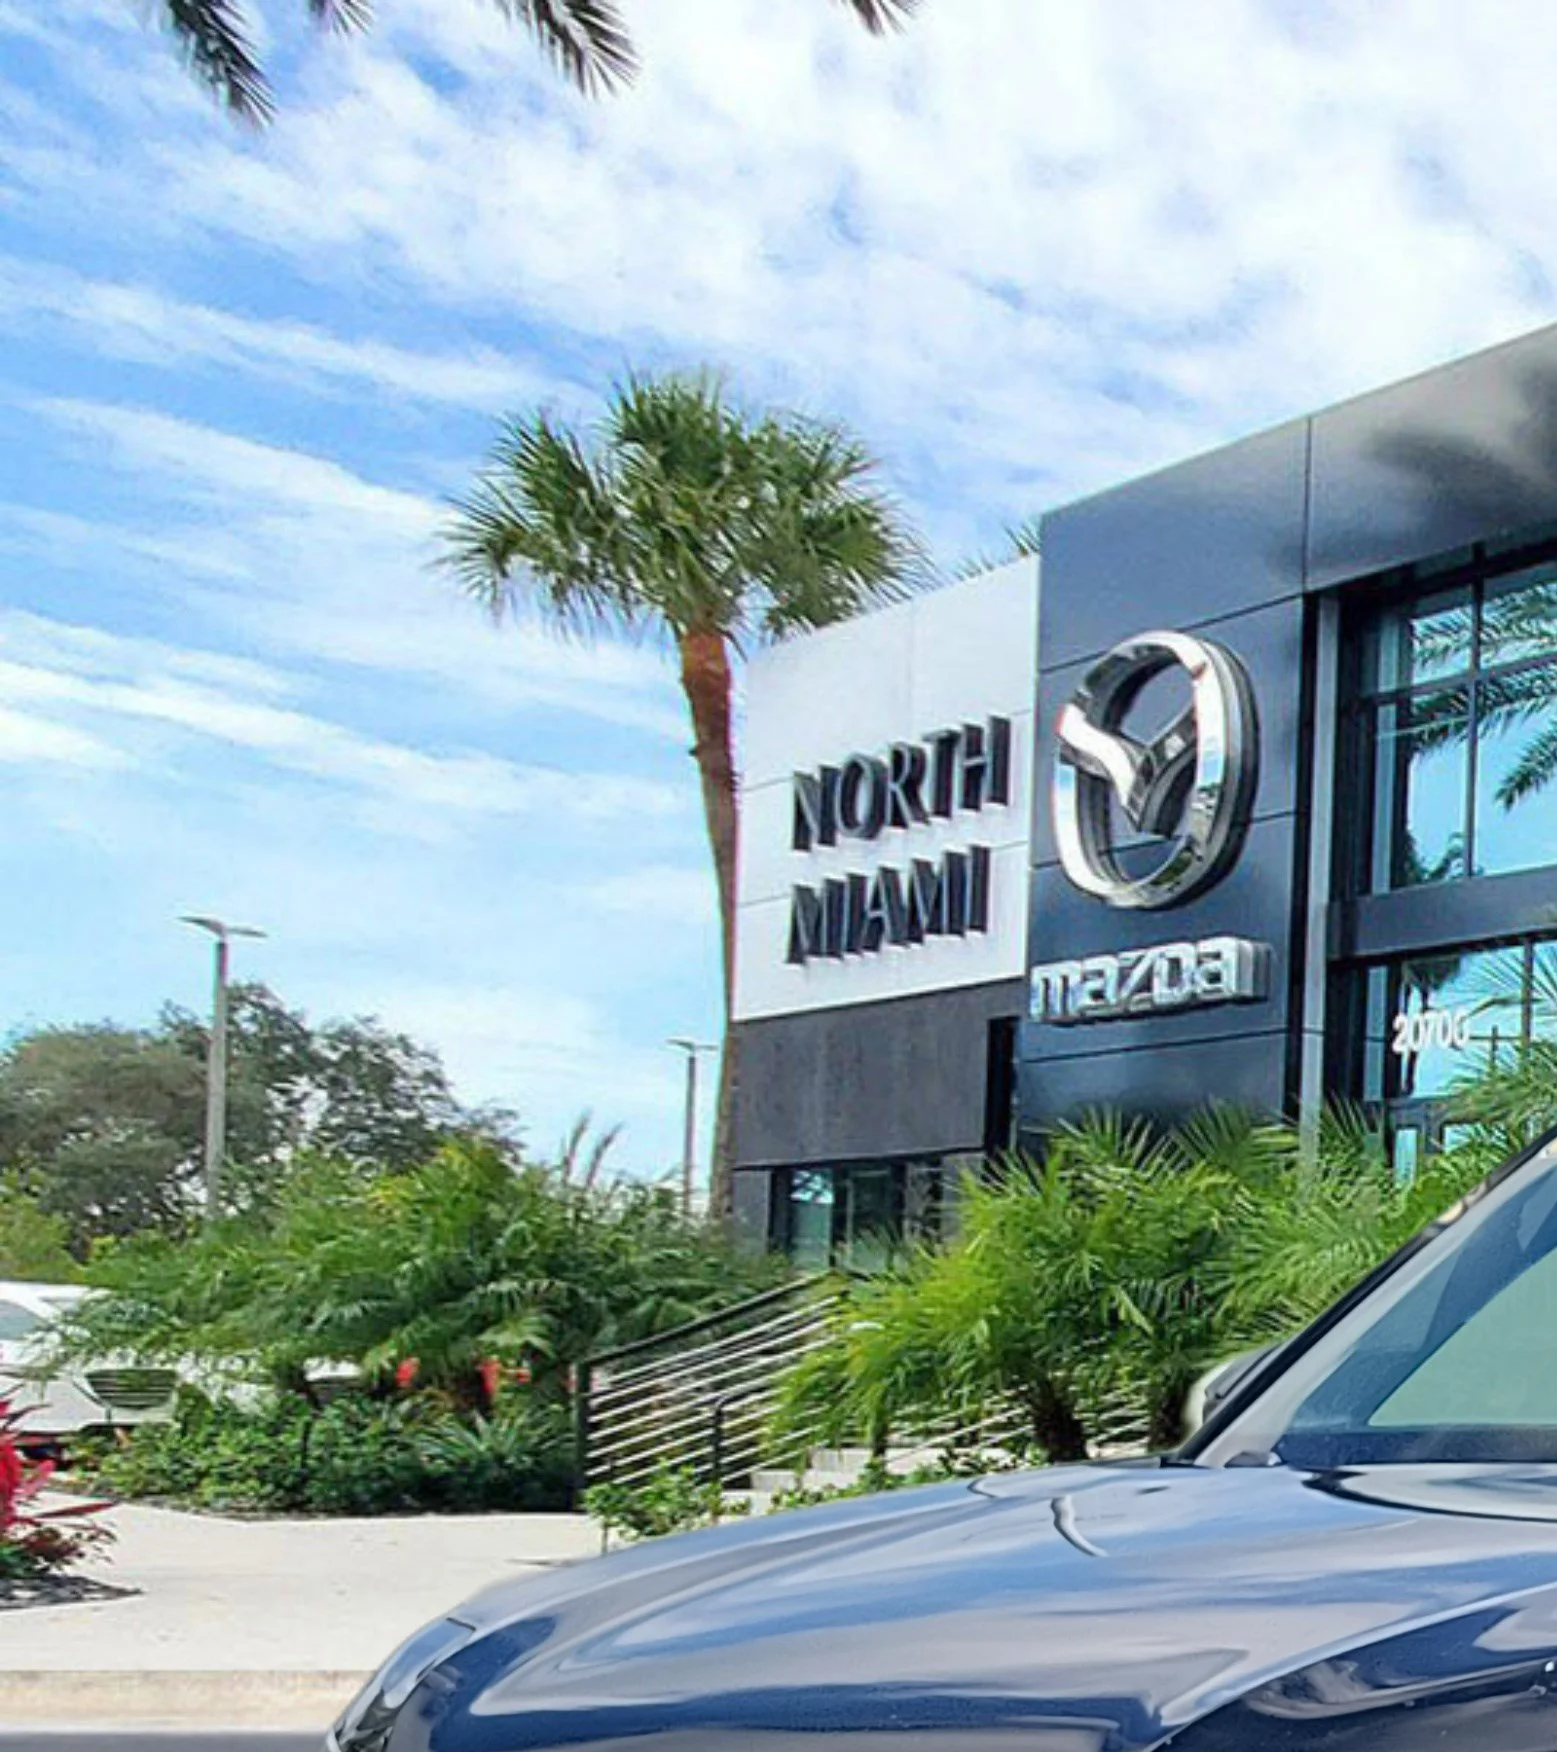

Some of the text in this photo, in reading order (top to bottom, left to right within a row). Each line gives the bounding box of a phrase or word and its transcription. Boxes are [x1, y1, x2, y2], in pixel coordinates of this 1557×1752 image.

[792, 715, 1012, 852] NORTH
[786, 844, 992, 966] MIAMI
[1029, 936, 1254, 1023] mazda
